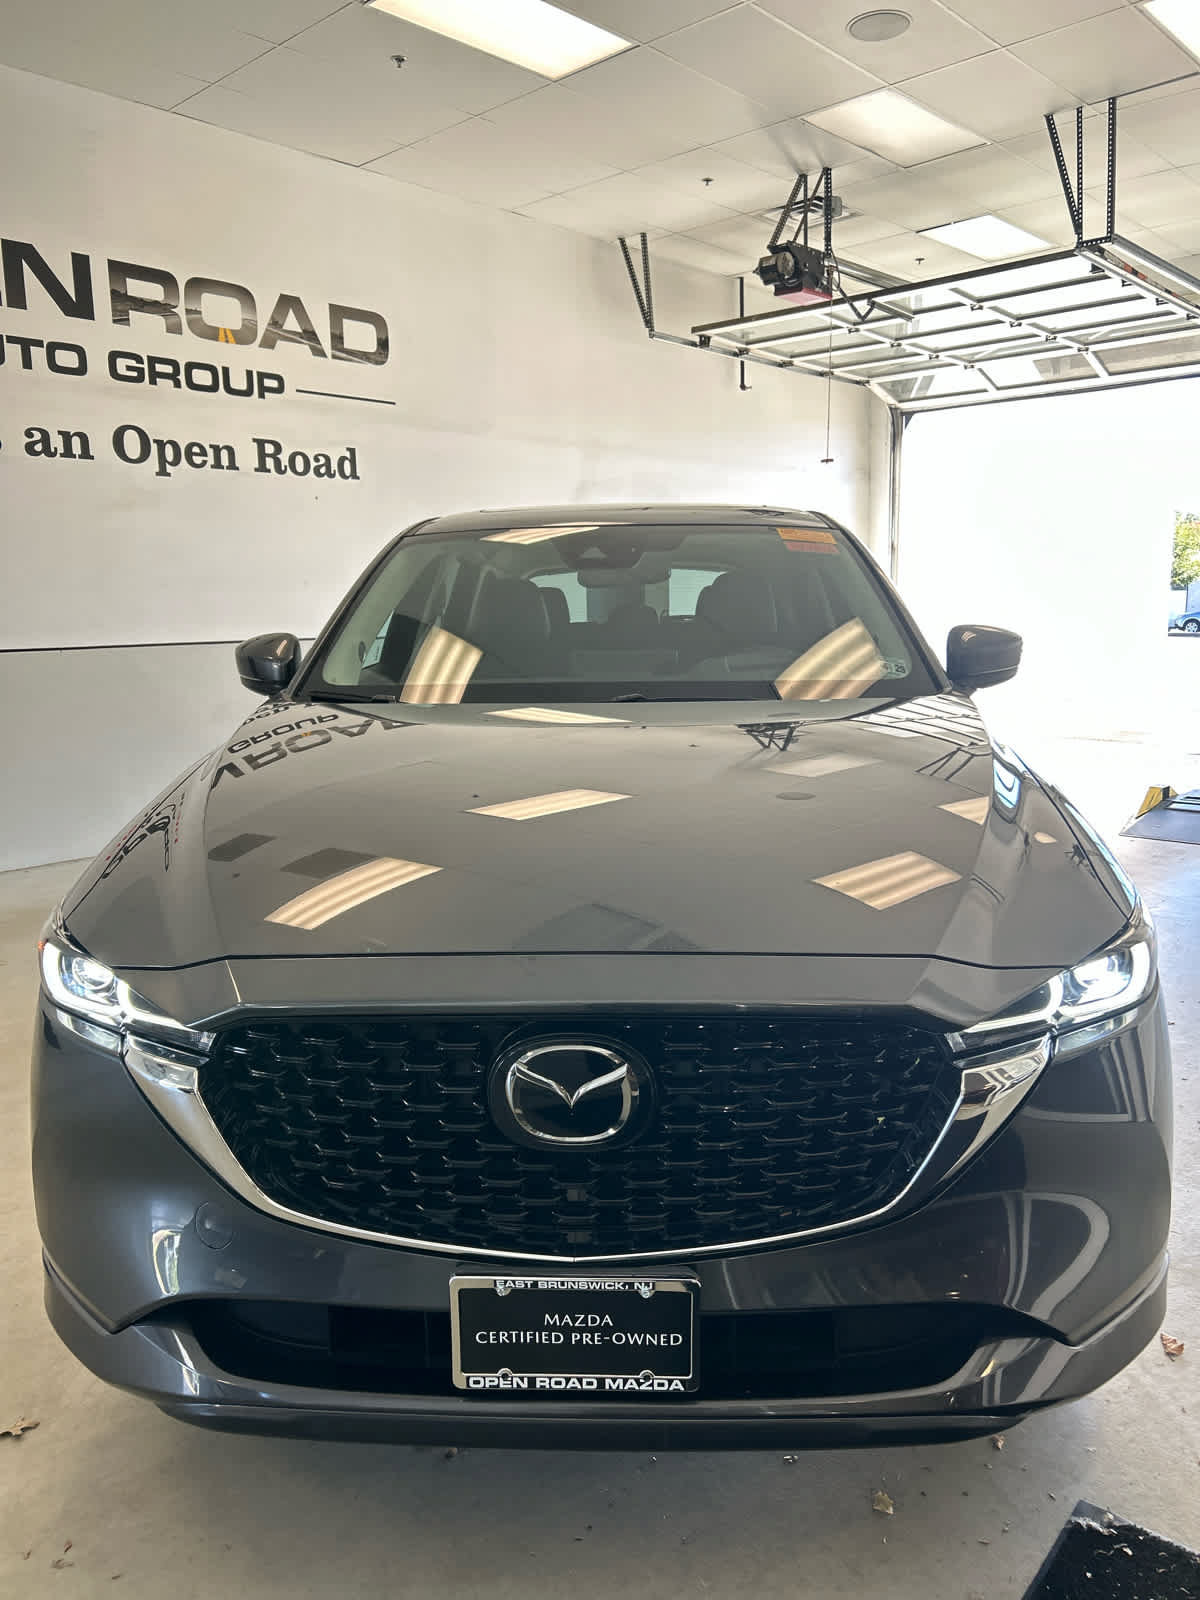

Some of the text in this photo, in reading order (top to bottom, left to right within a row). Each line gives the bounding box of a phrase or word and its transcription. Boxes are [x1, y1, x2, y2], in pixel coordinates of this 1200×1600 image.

[0, 238, 390, 366] N ROAD
[0, 333, 285, 399] TO GROUP
[24, 424, 360, 480] an Open Road
[495, 1280, 533, 1289] EAST
[538, 1281, 629, 1290] BRUNSWICK,
[544, 1314, 613, 1327] MAZDA
[475, 1331, 683, 1346] CERTIFIED PRE-OWNED
[468, 1376, 684, 1391] OPEN ROAD MAZDA
